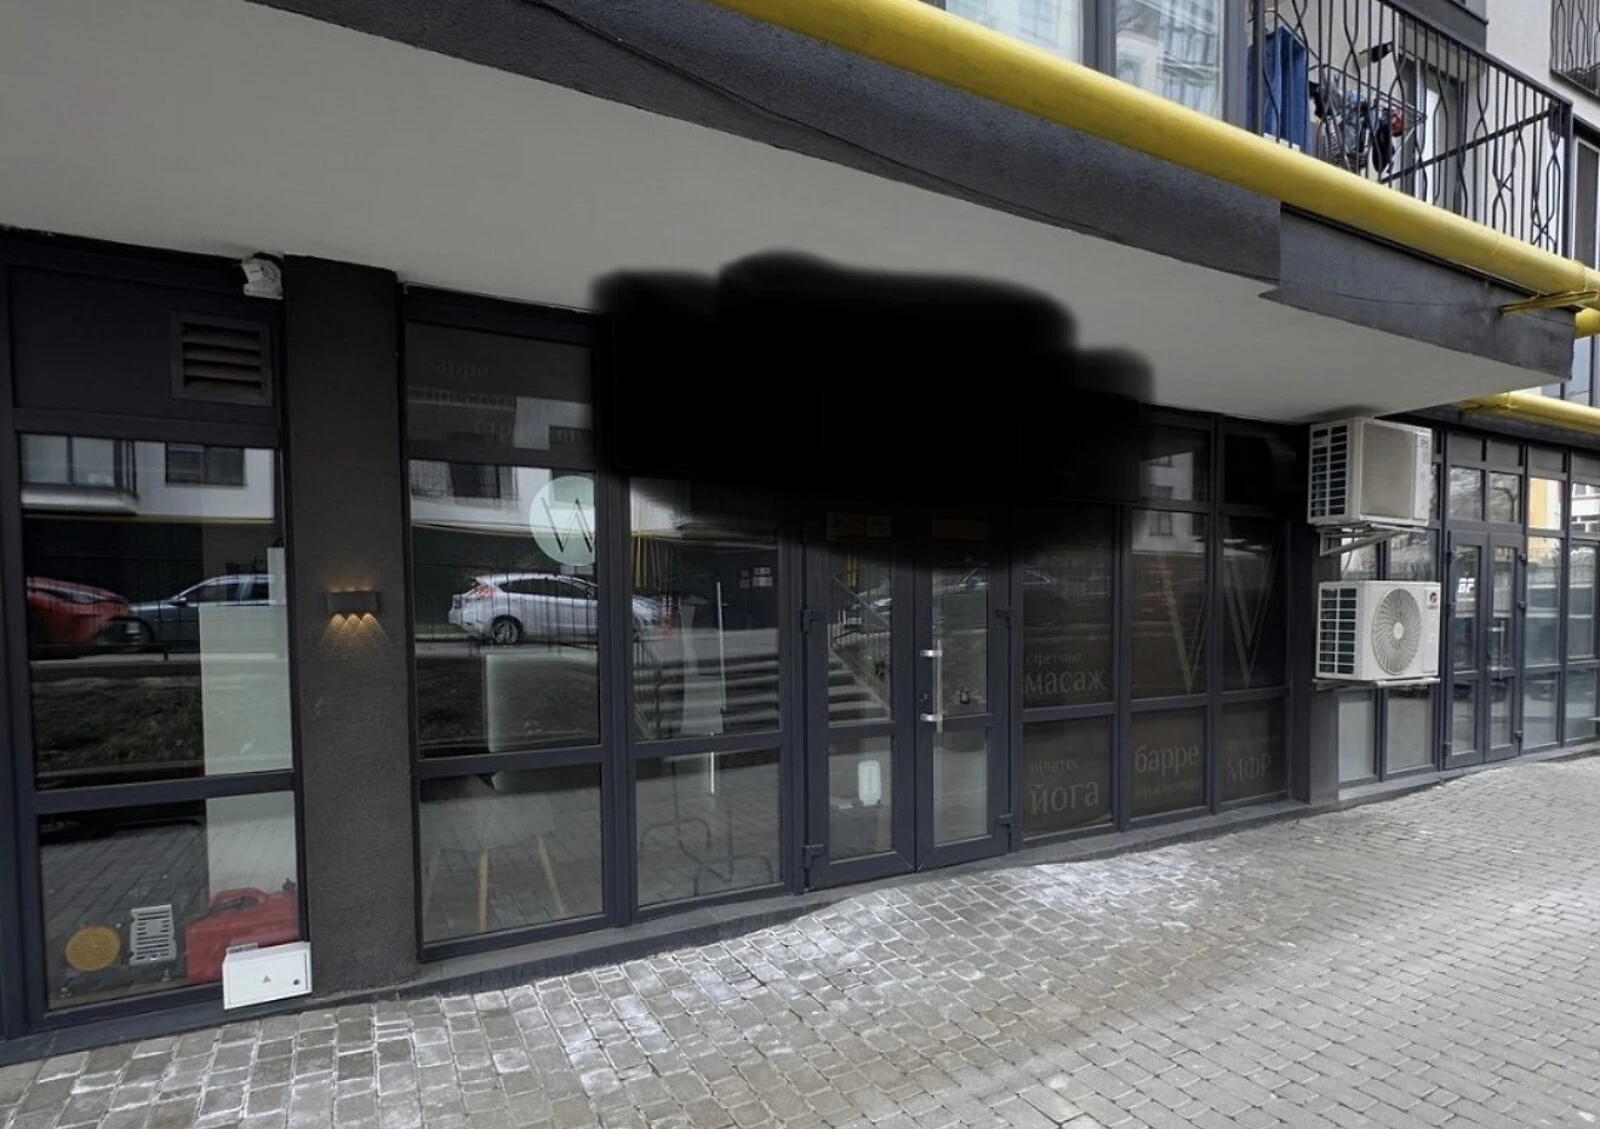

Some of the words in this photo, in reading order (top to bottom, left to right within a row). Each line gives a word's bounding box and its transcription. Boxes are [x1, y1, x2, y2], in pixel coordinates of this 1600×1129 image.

[1025, 668, 1107, 696] масаж
[1134, 743, 1200, 778] барре
[1029, 780, 1100, 816] йога
